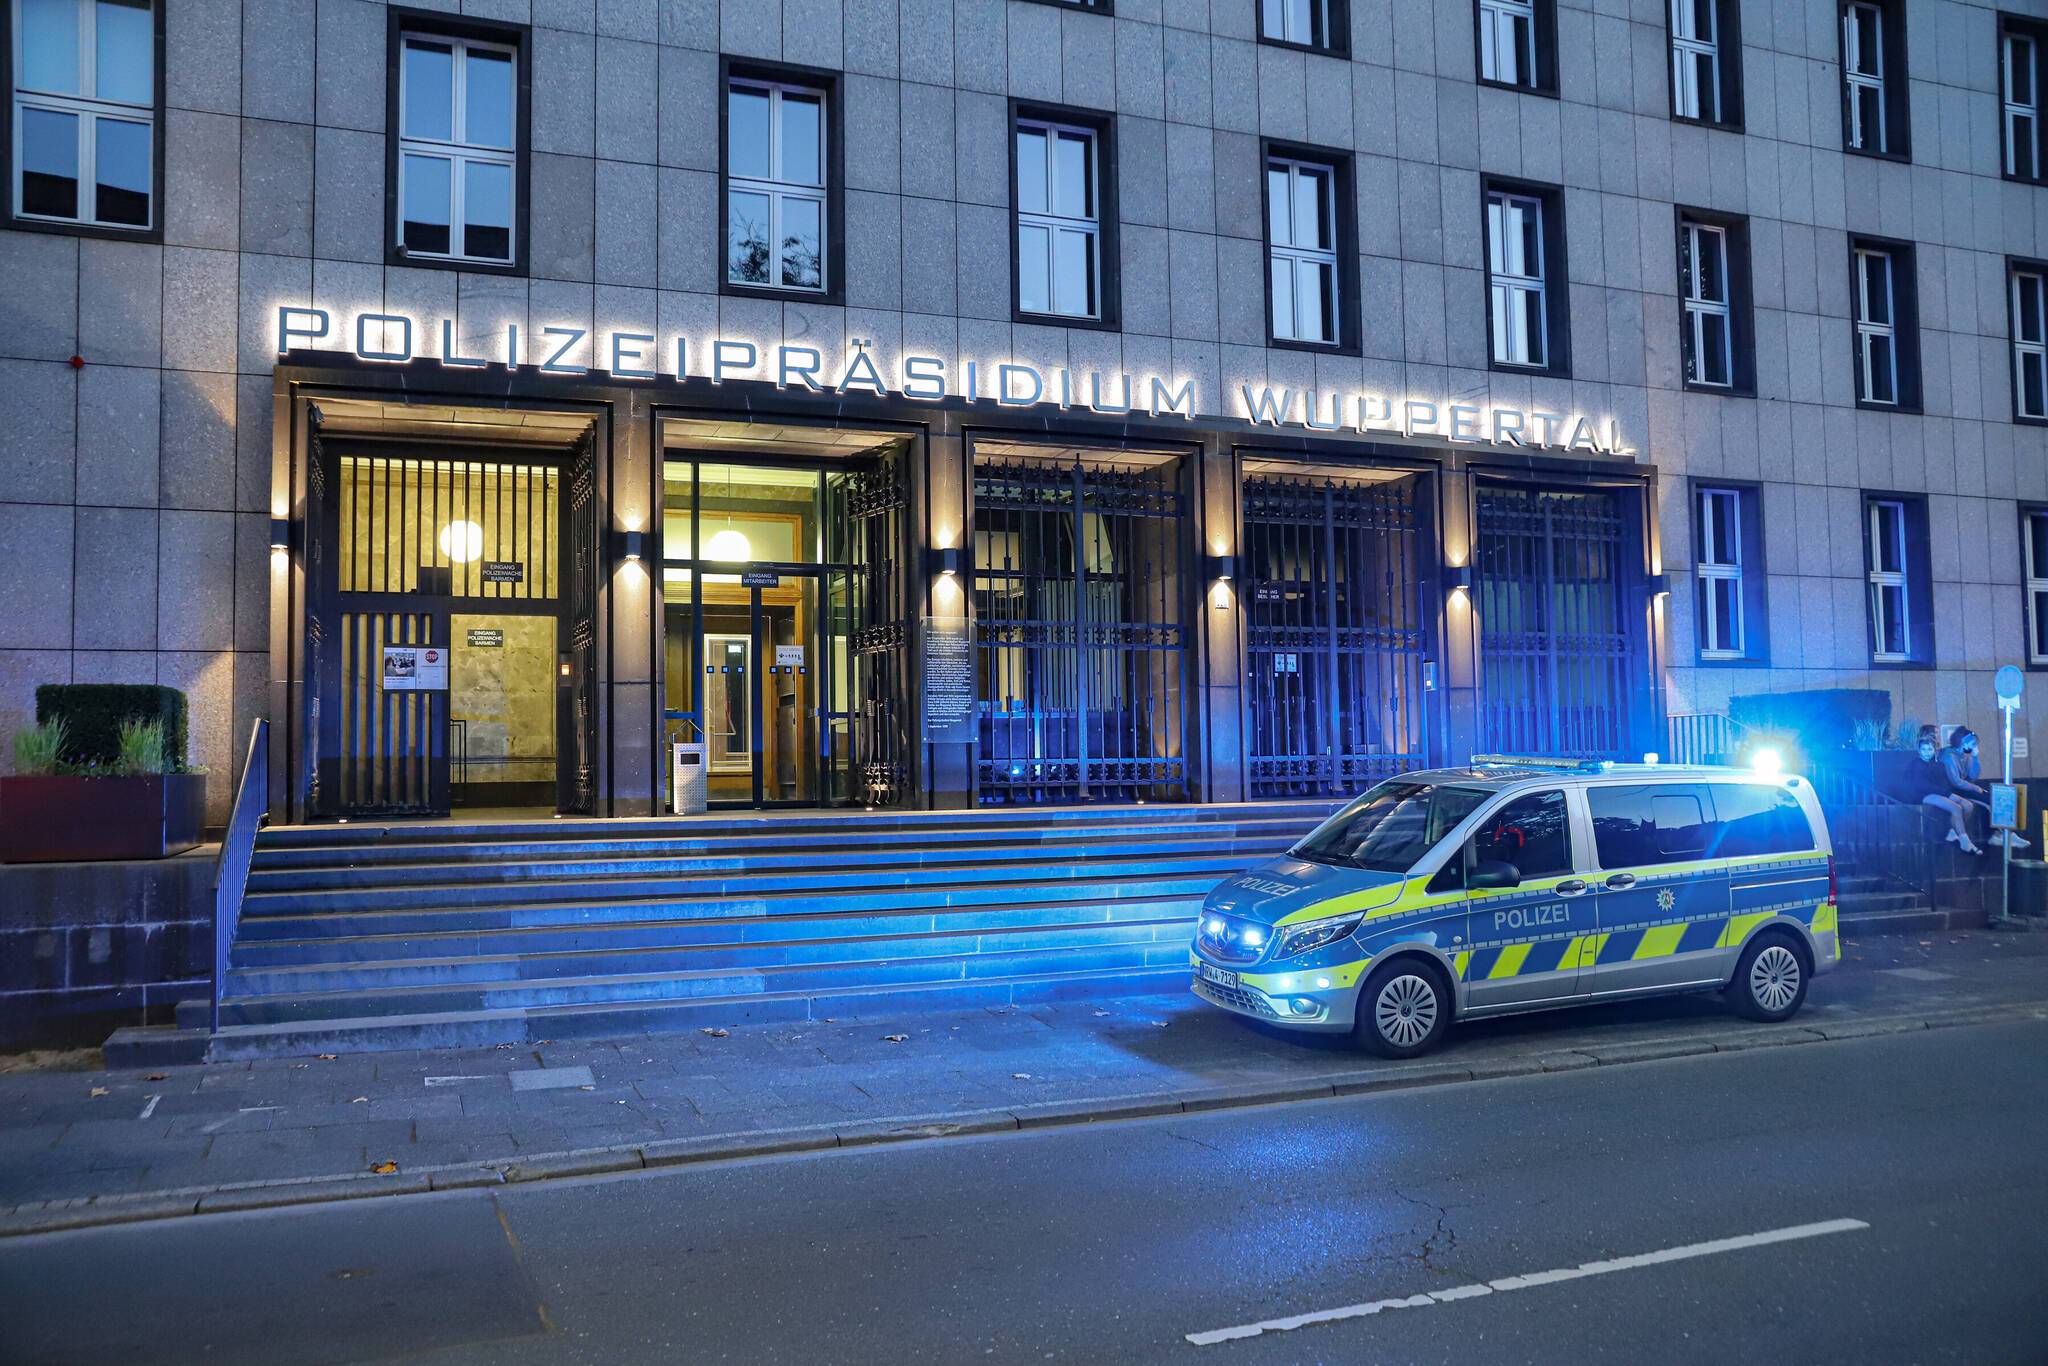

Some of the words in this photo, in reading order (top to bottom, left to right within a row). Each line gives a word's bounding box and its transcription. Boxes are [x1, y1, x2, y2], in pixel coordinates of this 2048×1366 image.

[277, 306, 1197, 419] POLIZEIPRÄSIDIUM
[1241, 379, 1637, 457] WUPPERTAL
[1232, 876, 1301, 897] POLIZEI
[1494, 903, 1570, 931] POLIZEI
